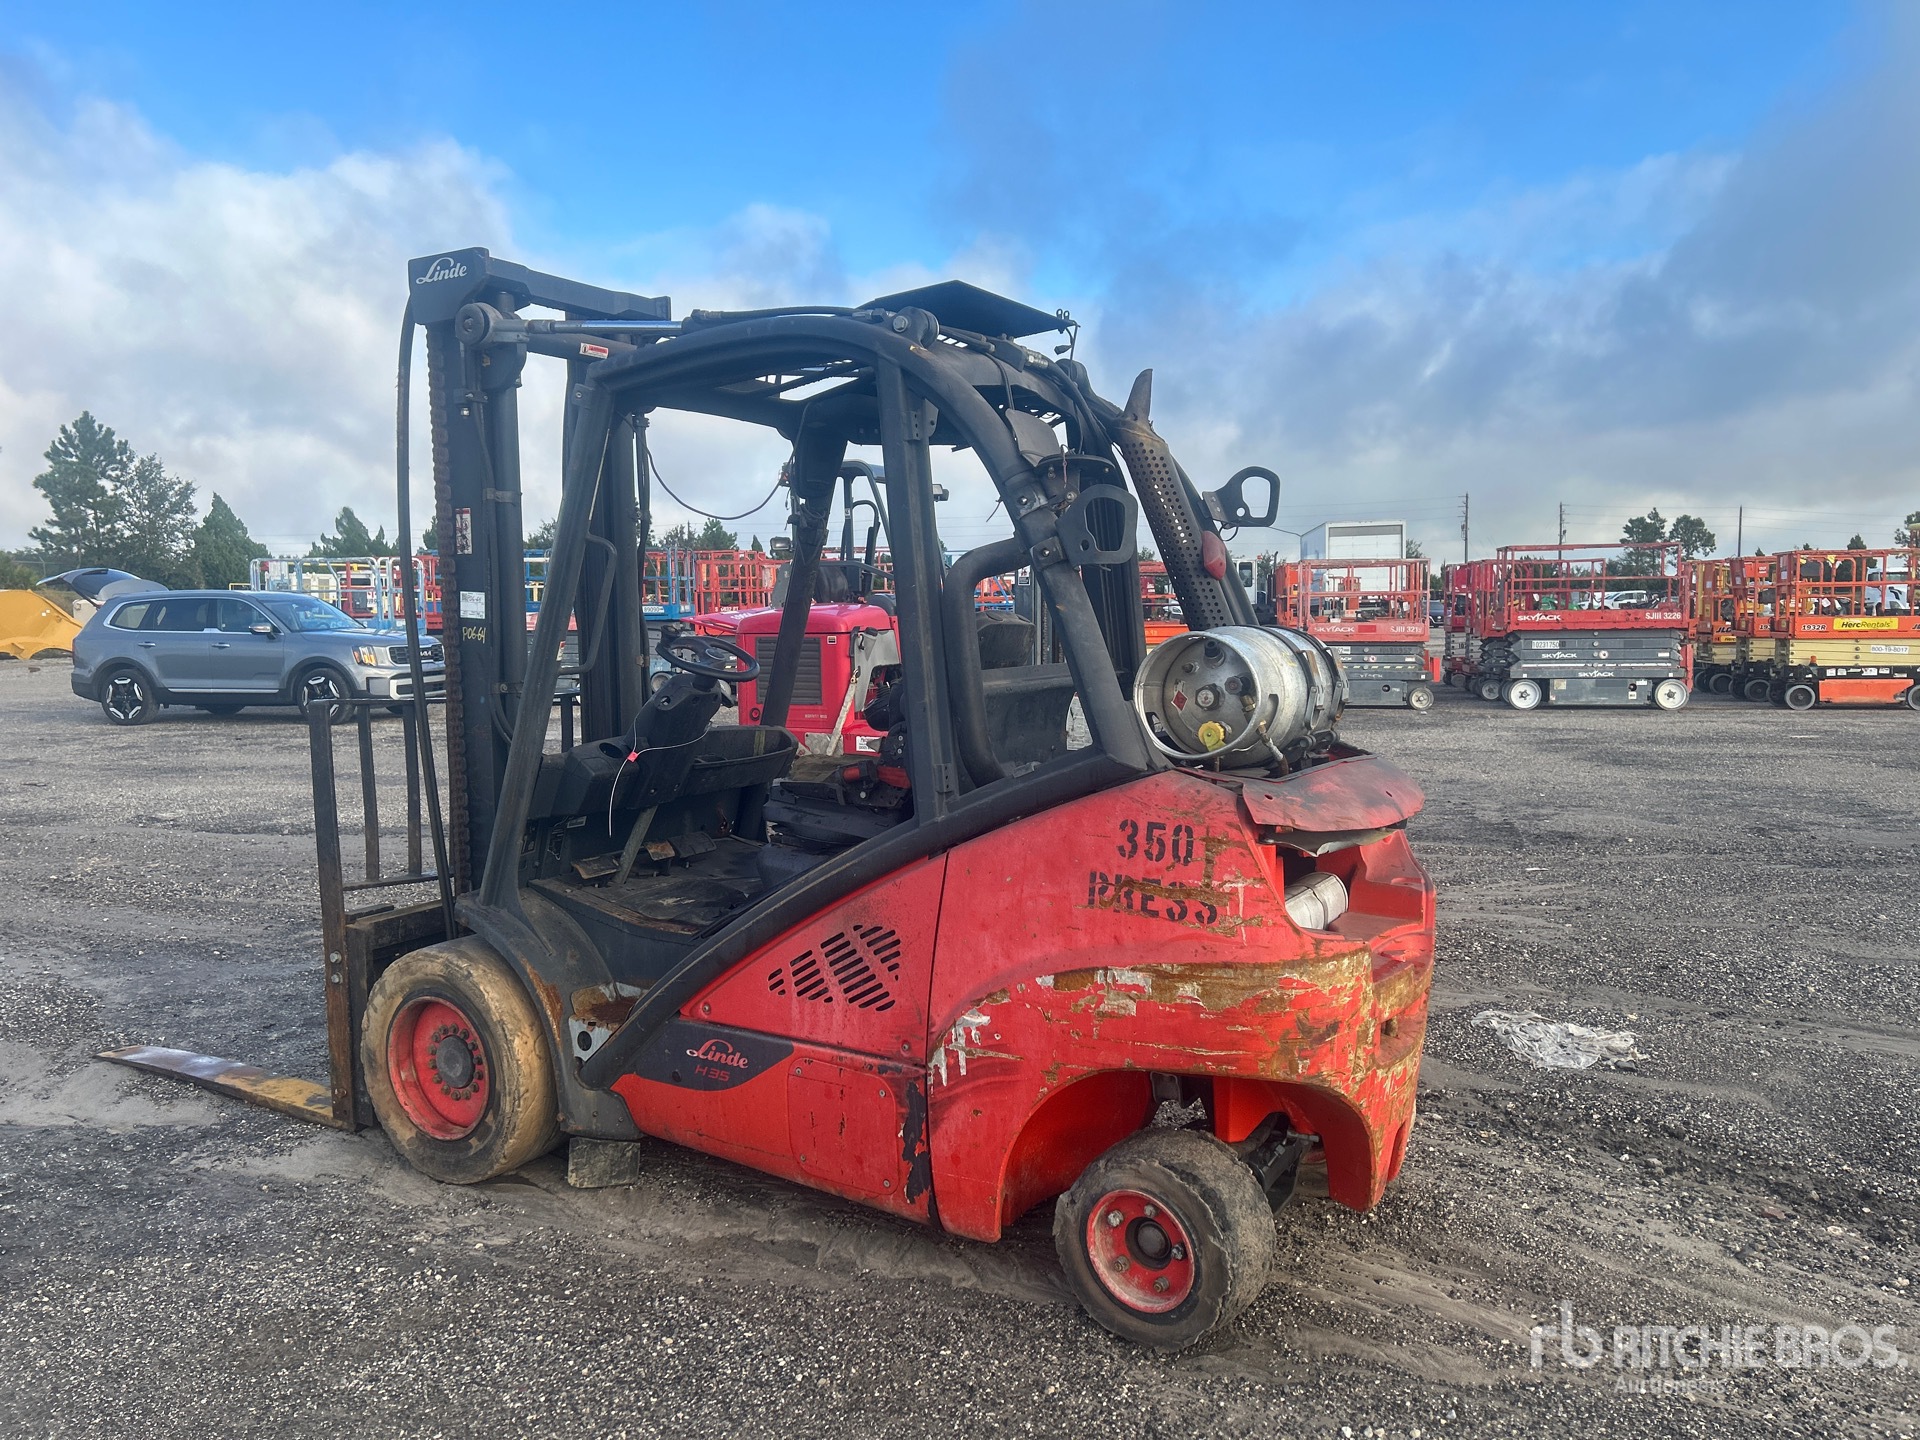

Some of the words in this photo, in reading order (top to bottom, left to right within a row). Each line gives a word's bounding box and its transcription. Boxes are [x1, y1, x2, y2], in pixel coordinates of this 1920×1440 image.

[415, 257, 467, 284] Linde
[1517, 612, 1561, 621] SKYJACK
[1663, 612, 1682, 620] 3226
[1841, 621, 1891, 629] HercRentals
[462, 626, 486, 644] P06-64
[1116, 819, 1194, 866] 350
[686, 1039, 749, 1069] Linde
